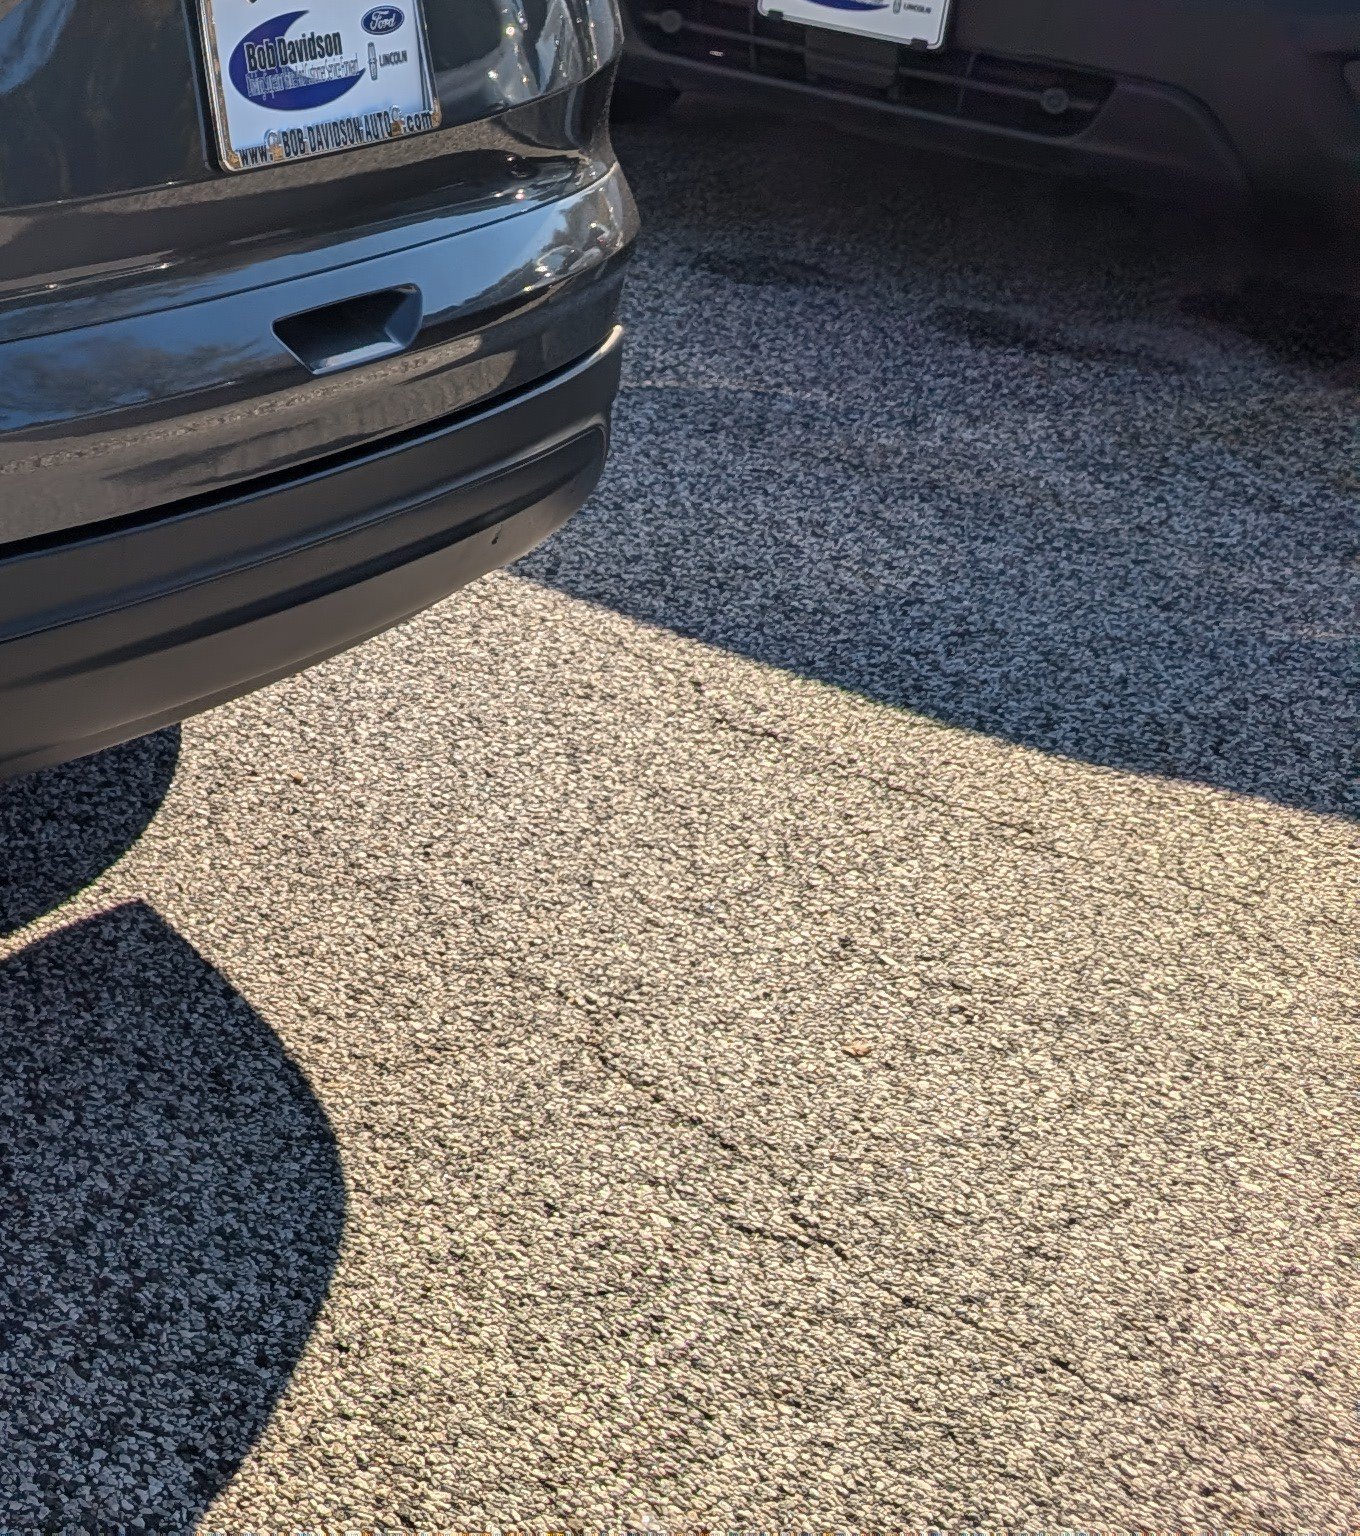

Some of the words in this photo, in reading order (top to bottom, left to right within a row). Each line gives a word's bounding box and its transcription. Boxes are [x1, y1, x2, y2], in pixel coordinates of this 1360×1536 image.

[370, 11, 397, 30] Ford
[244, 38, 278, 73] Bob
[277, 32, 343, 66] Davidson
[378, 50, 408, 69] LINCOLN
